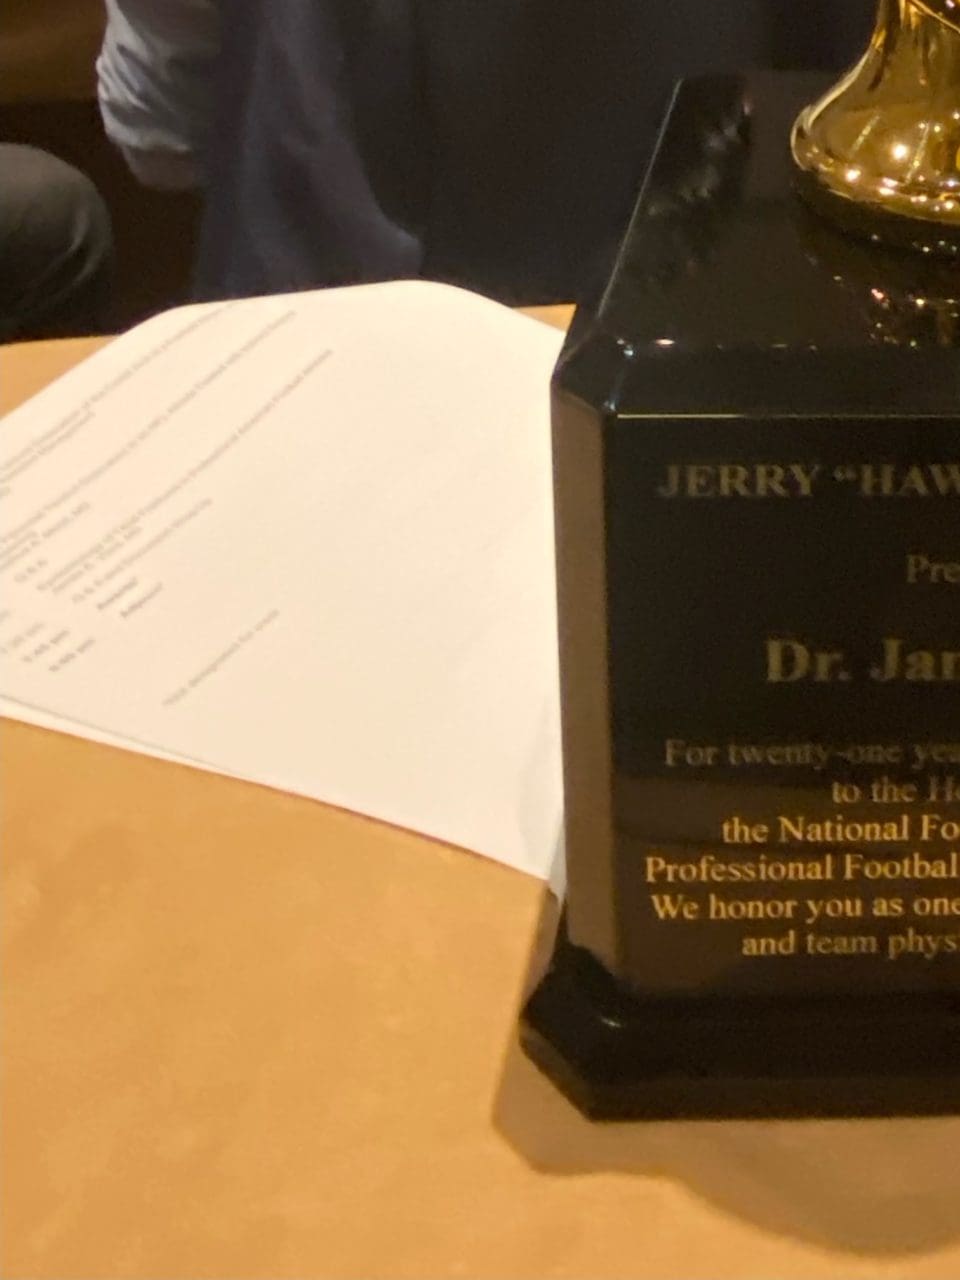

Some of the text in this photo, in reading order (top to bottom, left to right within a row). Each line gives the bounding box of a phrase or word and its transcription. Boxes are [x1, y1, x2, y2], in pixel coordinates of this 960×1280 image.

[659, 463, 819, 497] JERRY
[766, 638, 849, 683] Dr.
[664, 738, 719, 767] For
[727, 741, 903, 770] twenty-one
[831, 781, 862, 804] to
[871, 775, 917, 804] the
[721, 815, 769, 843] the
[778, 813, 910, 842] National
[645, 854, 833, 884] Professional
[650, 894, 699, 920] We
[708, 893, 798, 920] honor
[805, 898, 863, 925] you
[871, 897, 904, 917] as
[741, 929, 797, 957] and
[805, 932, 879, 955] team
